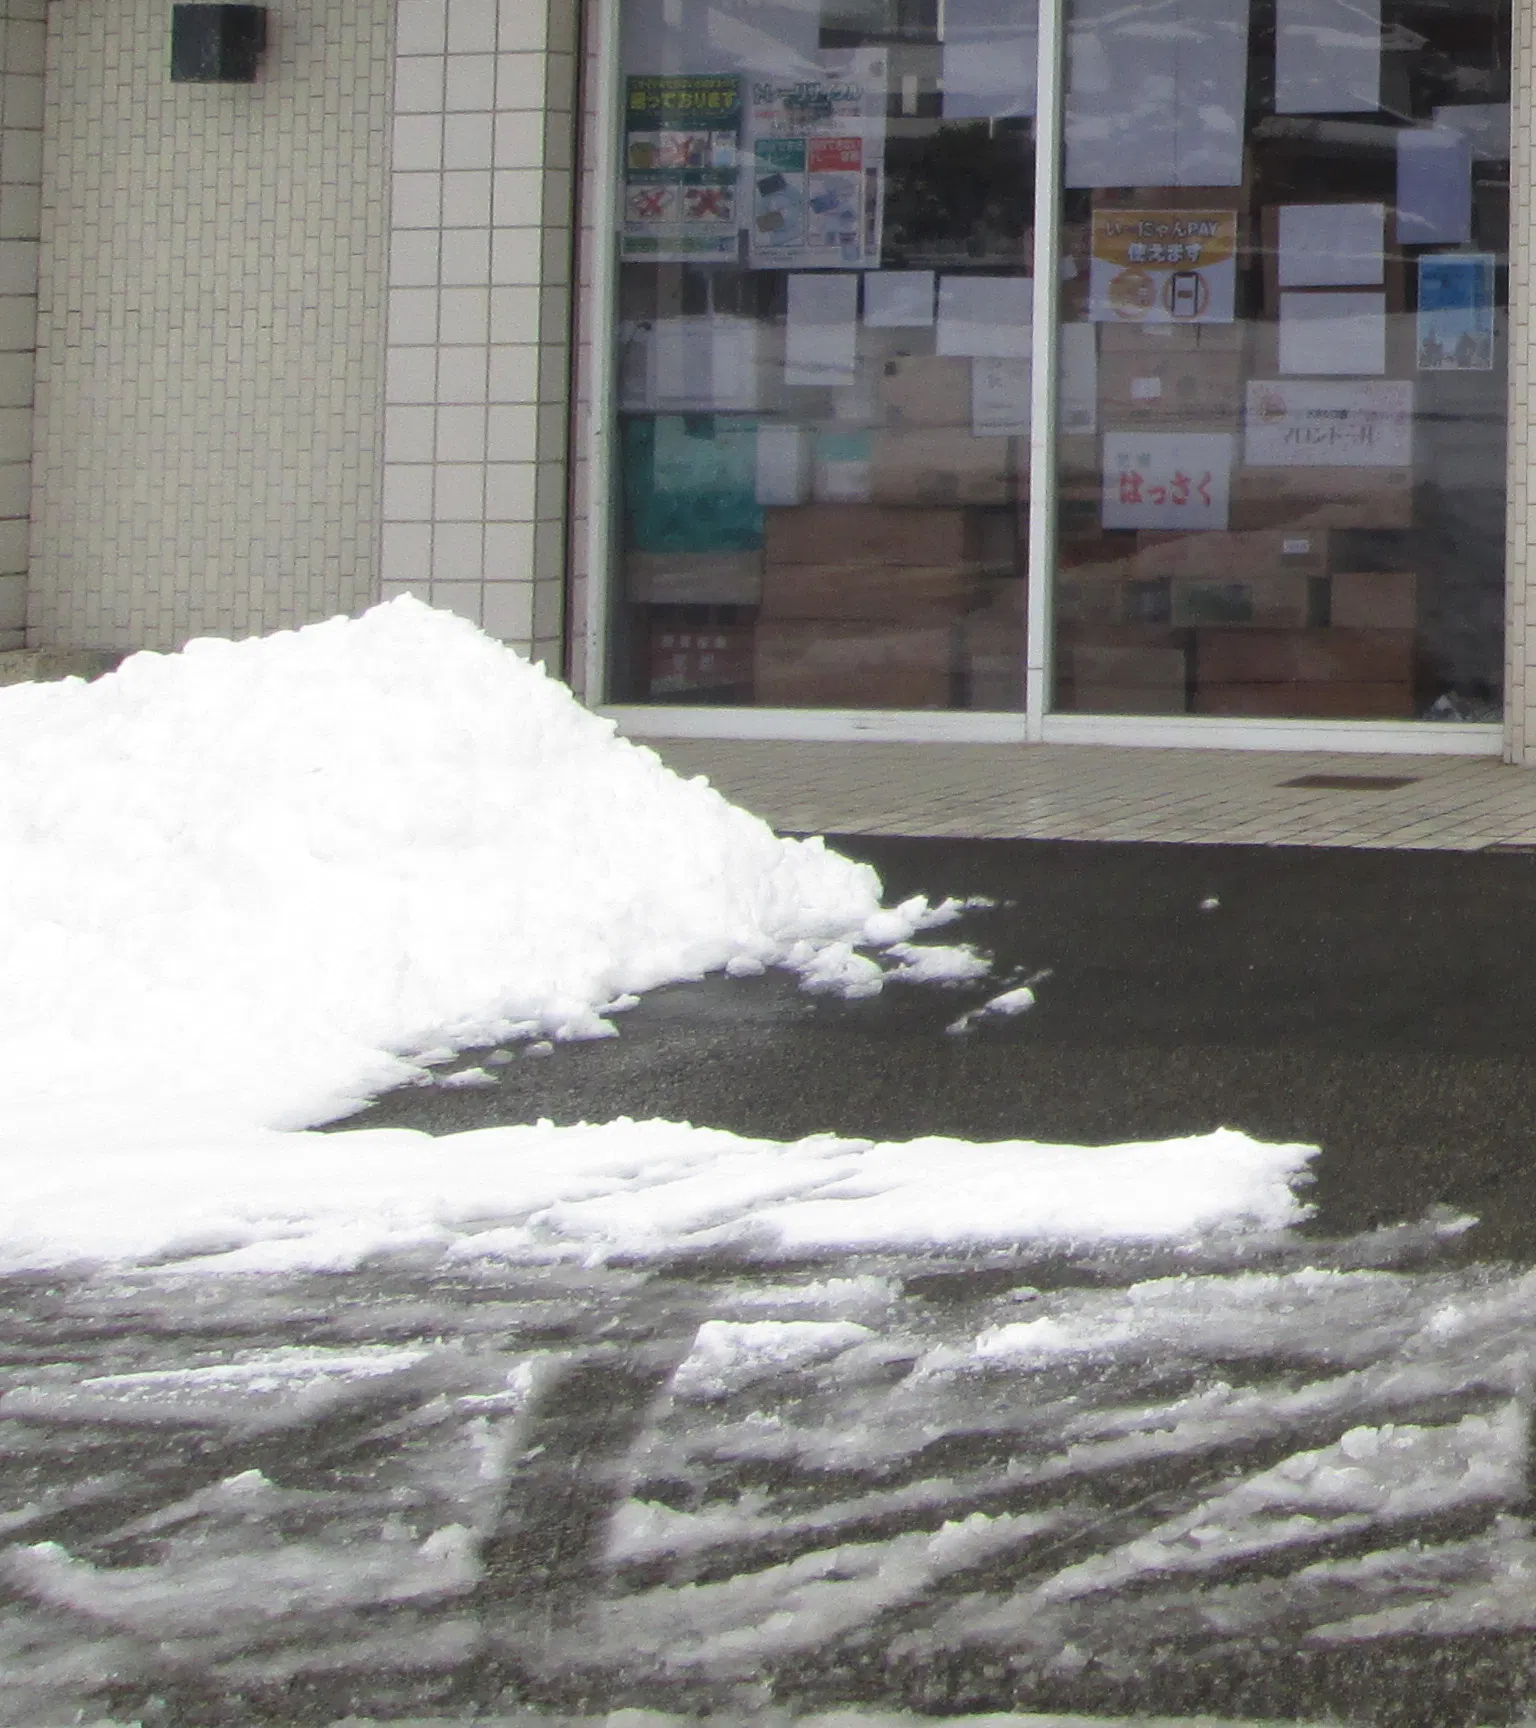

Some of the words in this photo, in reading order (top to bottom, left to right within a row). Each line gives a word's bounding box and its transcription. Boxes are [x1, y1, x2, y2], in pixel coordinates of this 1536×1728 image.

[1127, 242, 1203, 264] 使えます
[1119, 469, 1212, 508] はっさく
